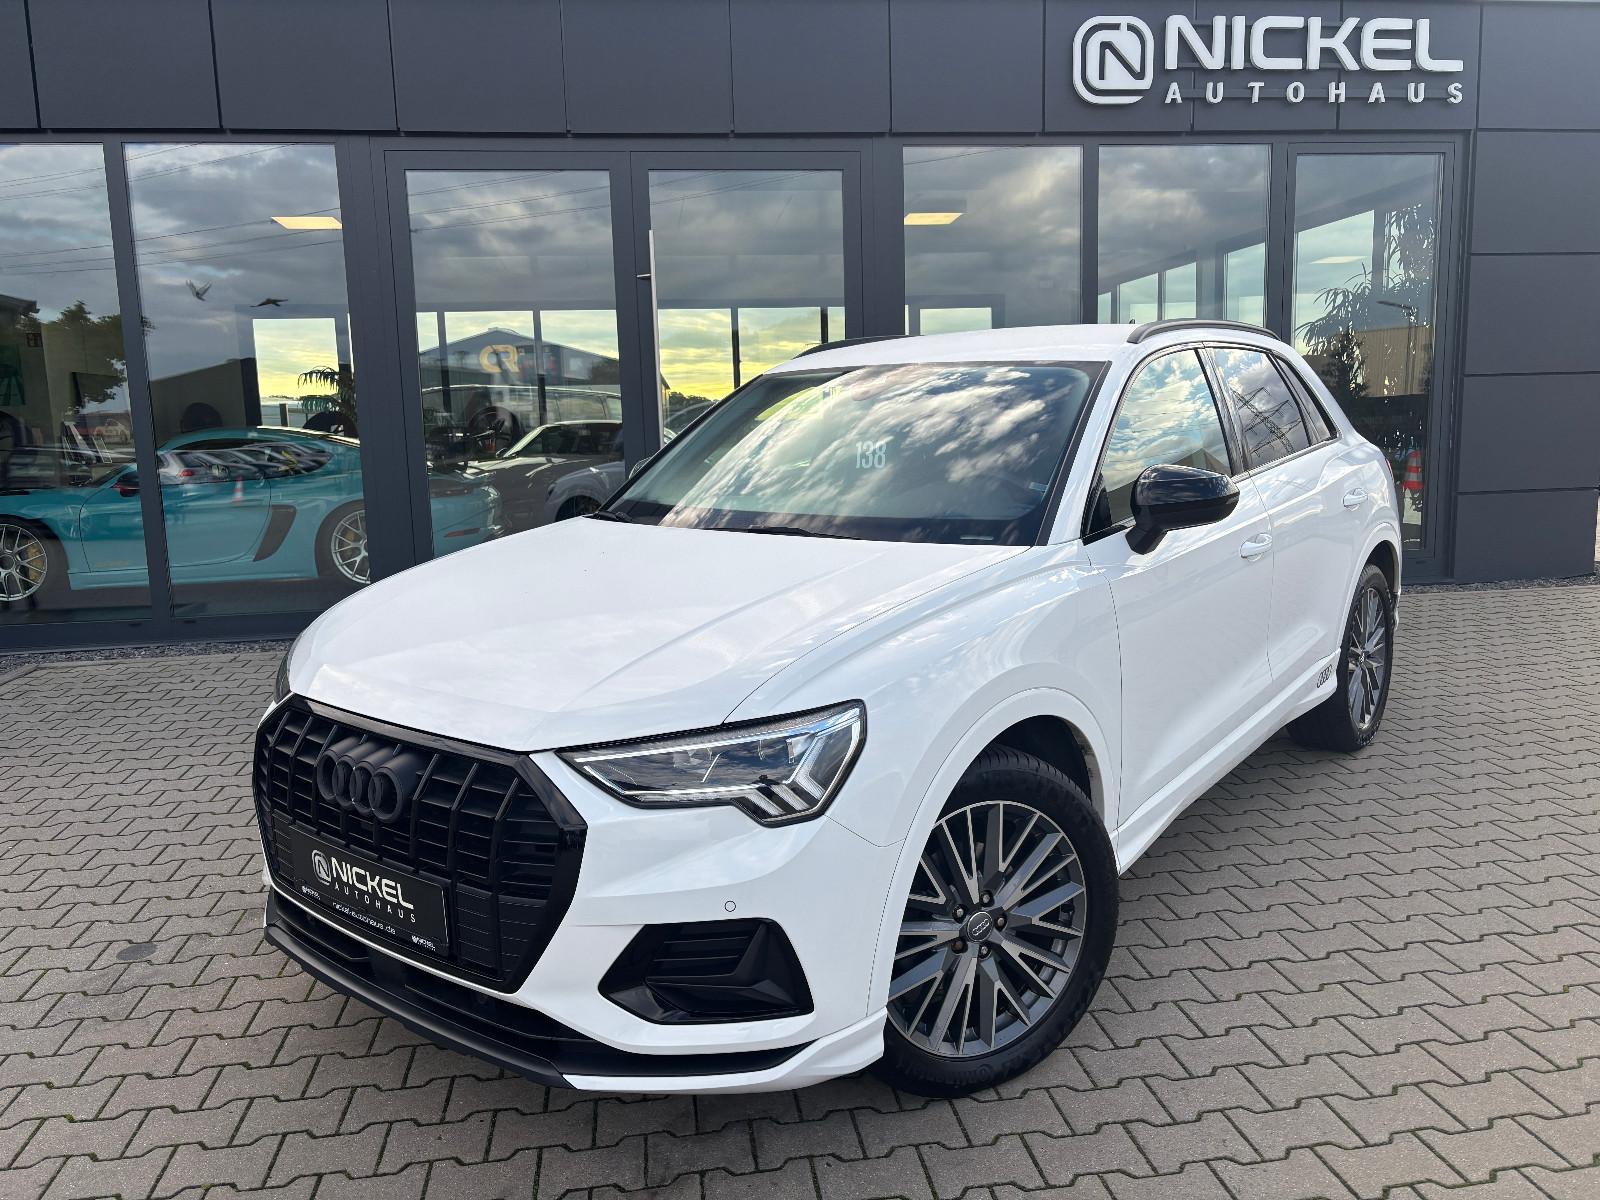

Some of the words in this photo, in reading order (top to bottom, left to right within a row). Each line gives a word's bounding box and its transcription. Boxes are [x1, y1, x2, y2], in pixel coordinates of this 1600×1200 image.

[1165, 14, 1464, 72] NICKEL
[1165, 82, 1464, 104] AUTOHAUS
[855, 440, 887, 469] 138
[331, 856, 415, 910] NICKEL
[334, 882, 416, 923] AUTOHAUS
